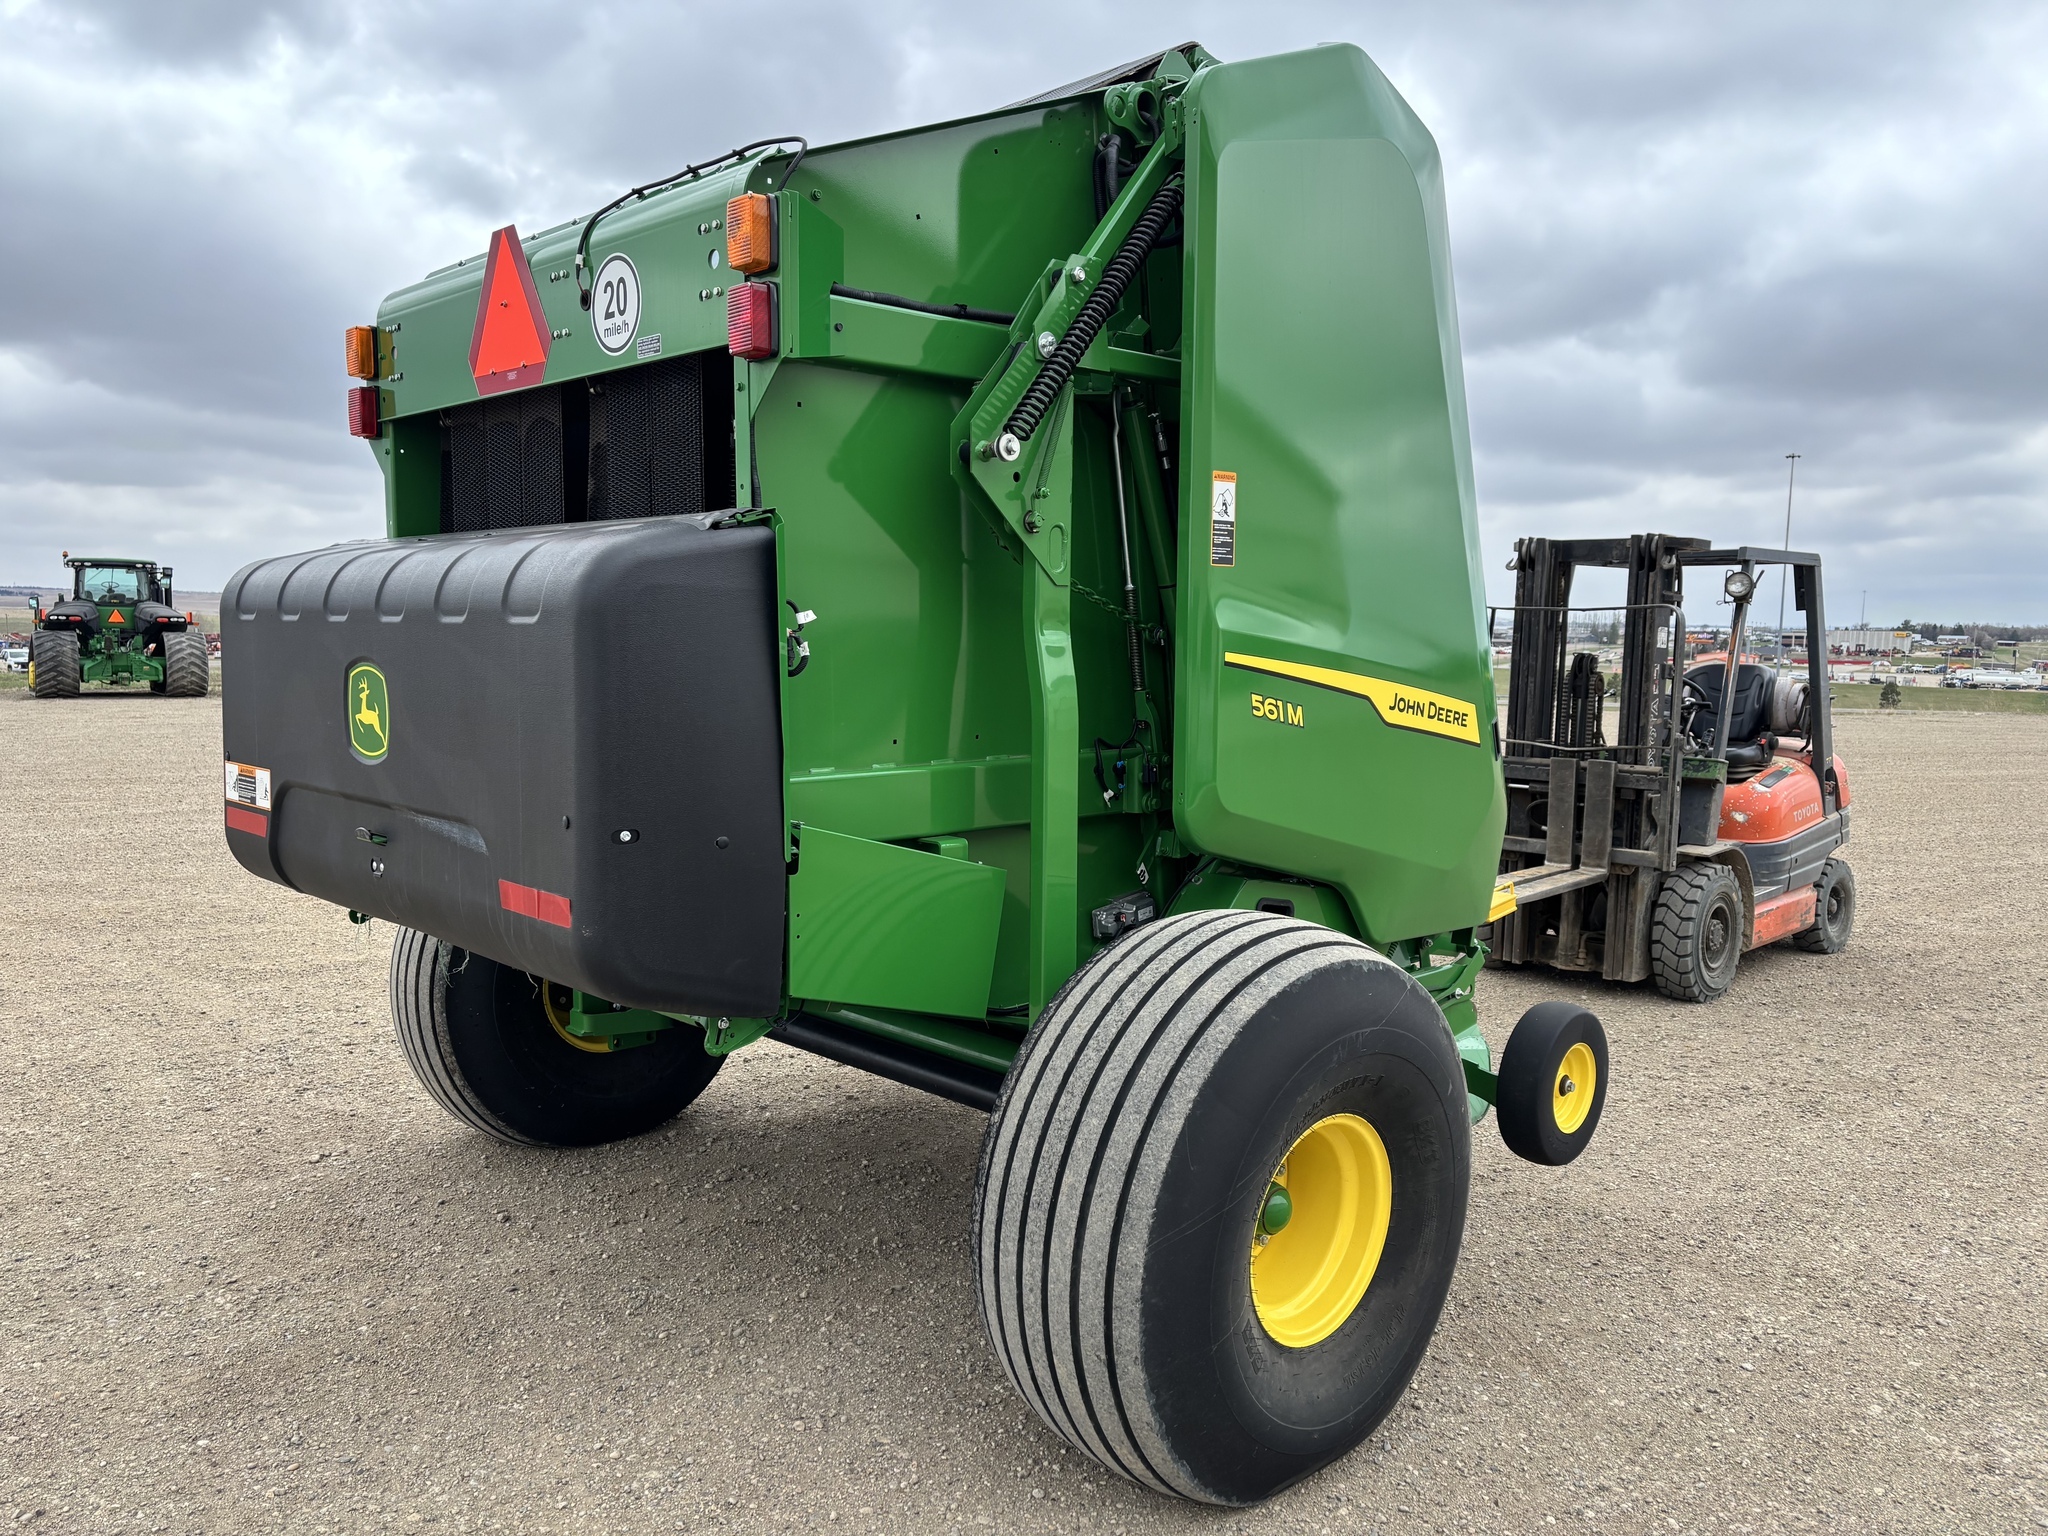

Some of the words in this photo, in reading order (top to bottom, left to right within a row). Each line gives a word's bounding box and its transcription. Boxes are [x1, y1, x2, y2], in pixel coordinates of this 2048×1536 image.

[603, 276, 628, 321] 20
[603, 320, 630, 339] mile/h
[1388, 692, 1425, 717] JOHN
[1427, 701, 1469, 728] DEERE
[1793, 802, 1820, 822] TOYOTA
